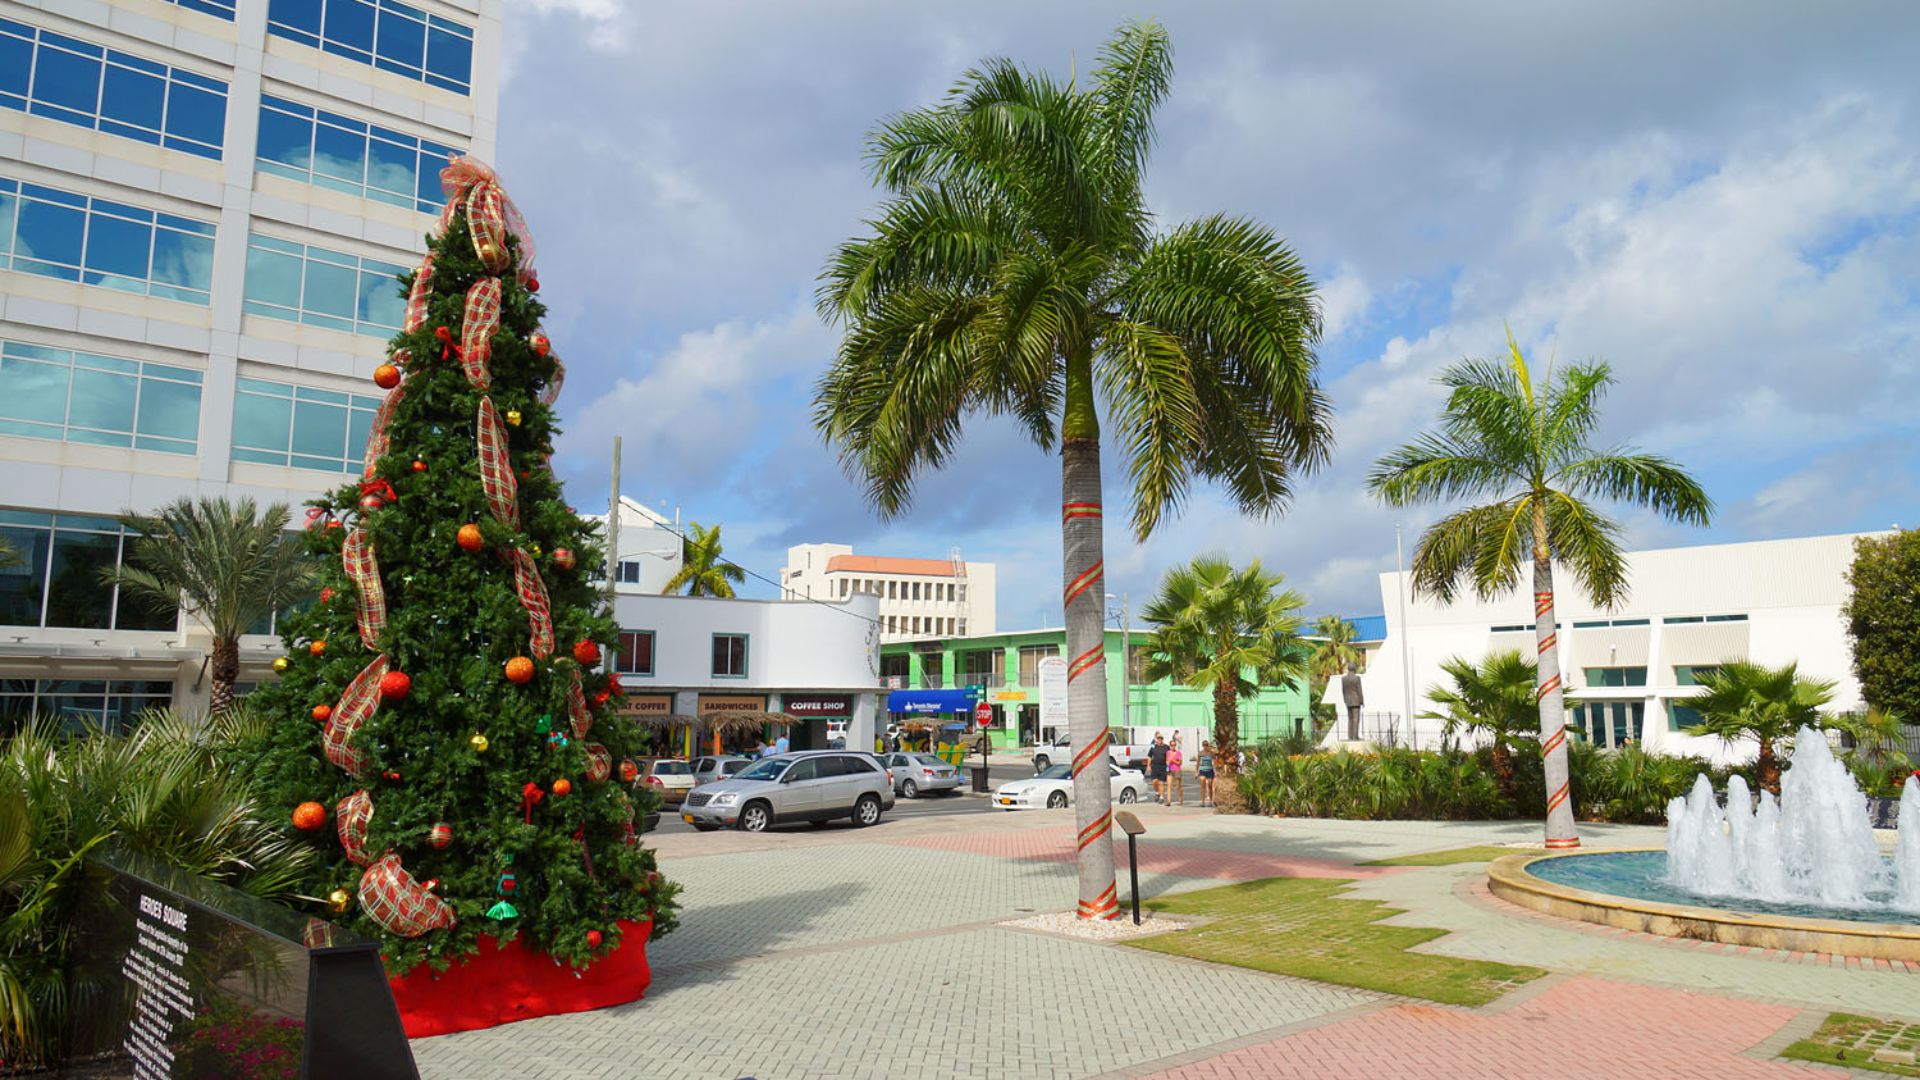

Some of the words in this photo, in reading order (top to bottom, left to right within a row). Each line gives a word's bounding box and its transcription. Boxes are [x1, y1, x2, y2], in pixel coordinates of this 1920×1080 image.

[635, 702, 667, 710] COFFEE
[704, 702, 758, 711] SANDWICHES
[790, 702, 822, 710] COFFEE
[823, 702, 845, 710] SHOP
[976, 709, 992, 719] STOP
[140, 894, 162, 919] HEROES
[163, 905, 187, 931] SQUARE
